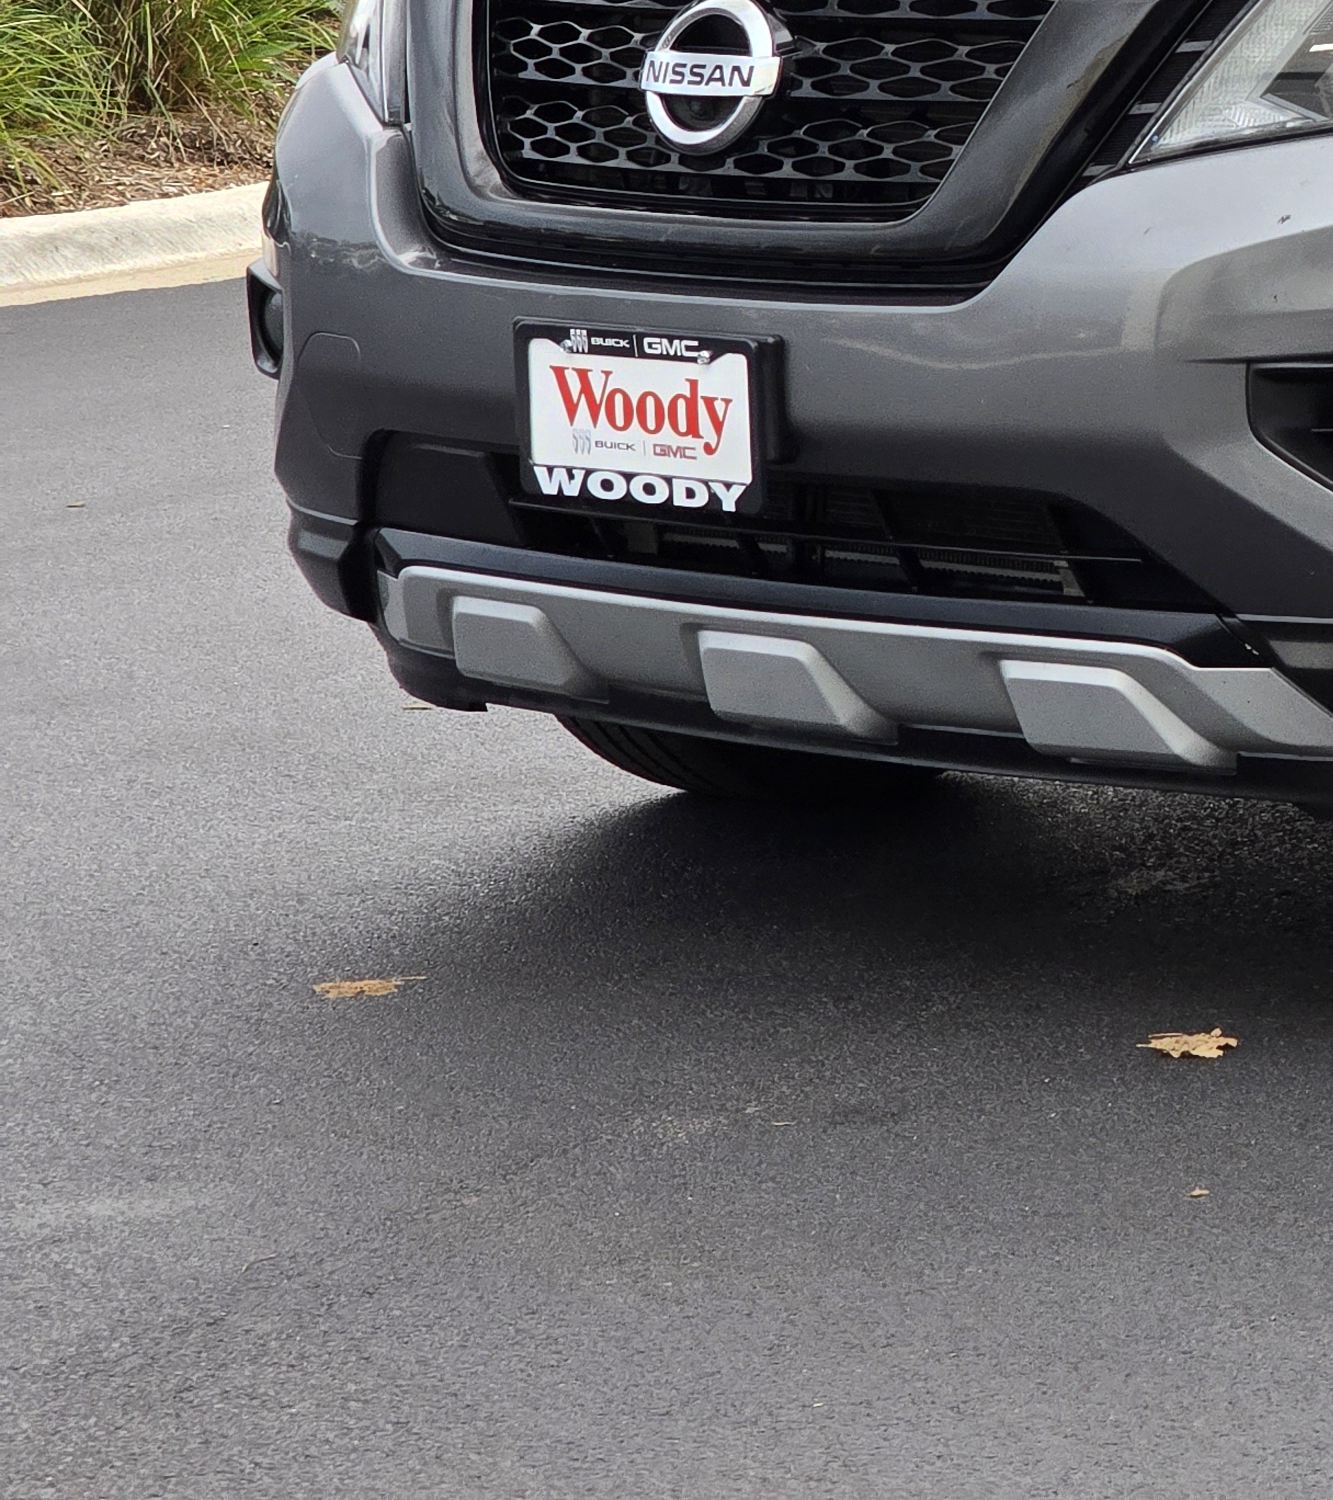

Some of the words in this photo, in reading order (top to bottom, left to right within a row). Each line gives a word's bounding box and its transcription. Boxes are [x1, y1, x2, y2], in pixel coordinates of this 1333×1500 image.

[646, 59, 755, 88] NISSAN
[591, 337, 630, 348] BUICK
[643, 338, 699, 357] GMC
[549, 365, 733, 457] Woody
[594, 439, 636, 452] BUICK
[653, 443, 697, 460] GMC
[533, 466, 748, 513] WOODY
